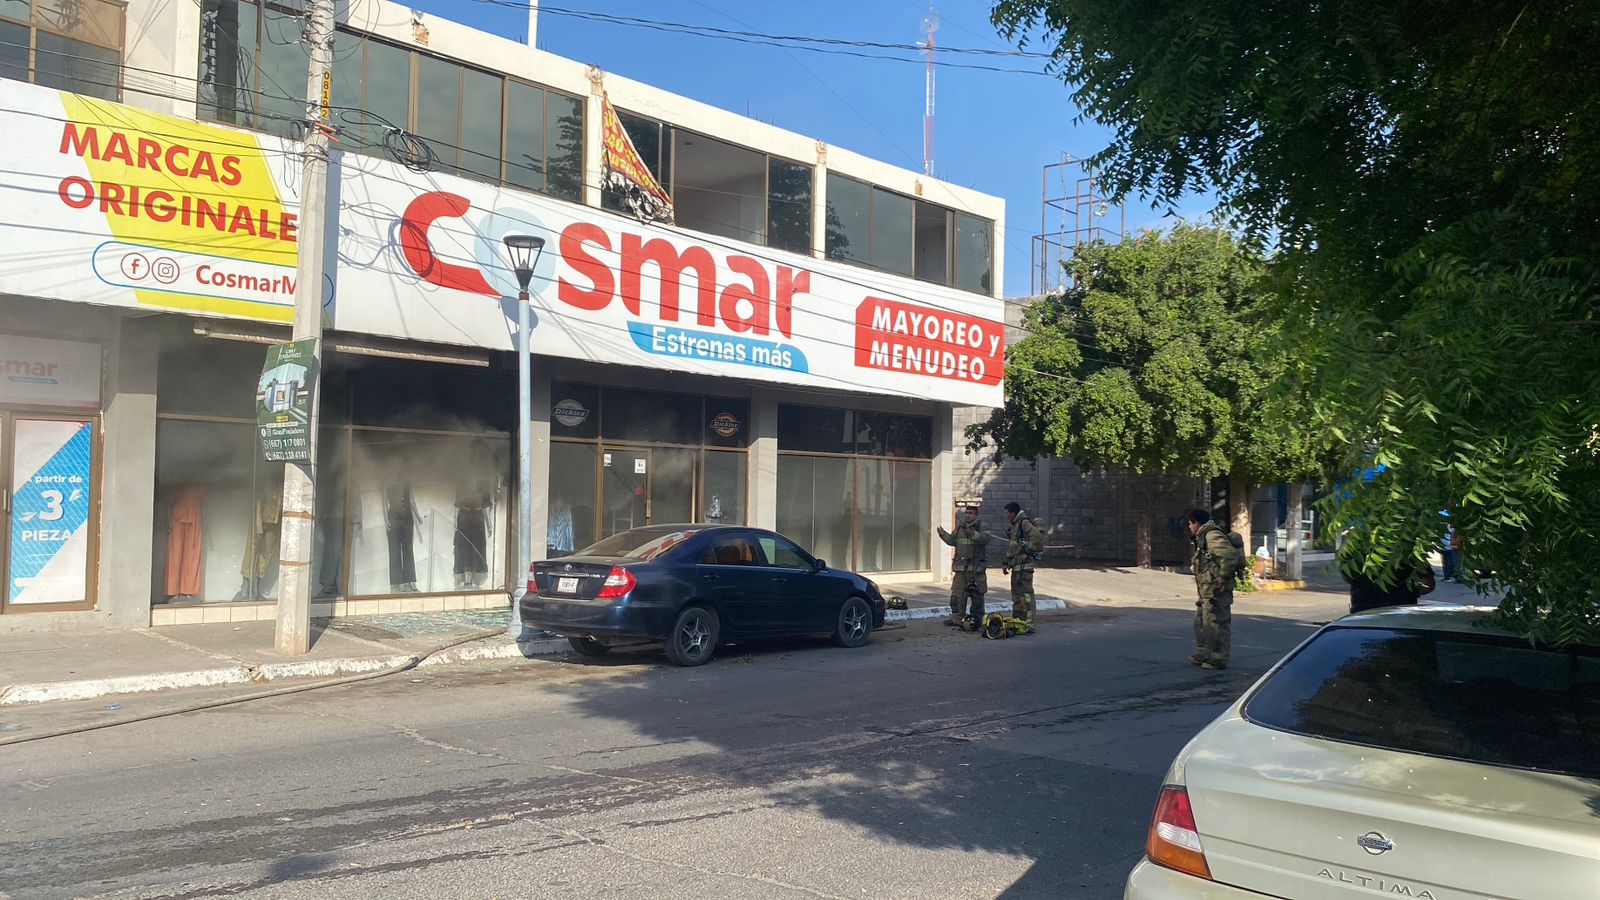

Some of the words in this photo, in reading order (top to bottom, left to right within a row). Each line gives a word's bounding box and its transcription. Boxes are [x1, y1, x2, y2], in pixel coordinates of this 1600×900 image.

[59, 122, 242, 186] MARCAS
[58, 175, 298, 242] ORIGINALE
[401, 191, 811, 340] Cosmar
[652, 325, 747, 362] Estrenas
[752, 342, 792, 368] más
[871, 305, 984, 349] MAYOREO
[989, 333, 1000, 358] y
[869, 340, 985, 381] MENUDEO
[35, 474, 67, 484] partir
[68, 473, 83, 483] de
[39, 489, 64, 521] 3
[1317, 868, 1437, 900] ALTIMA
